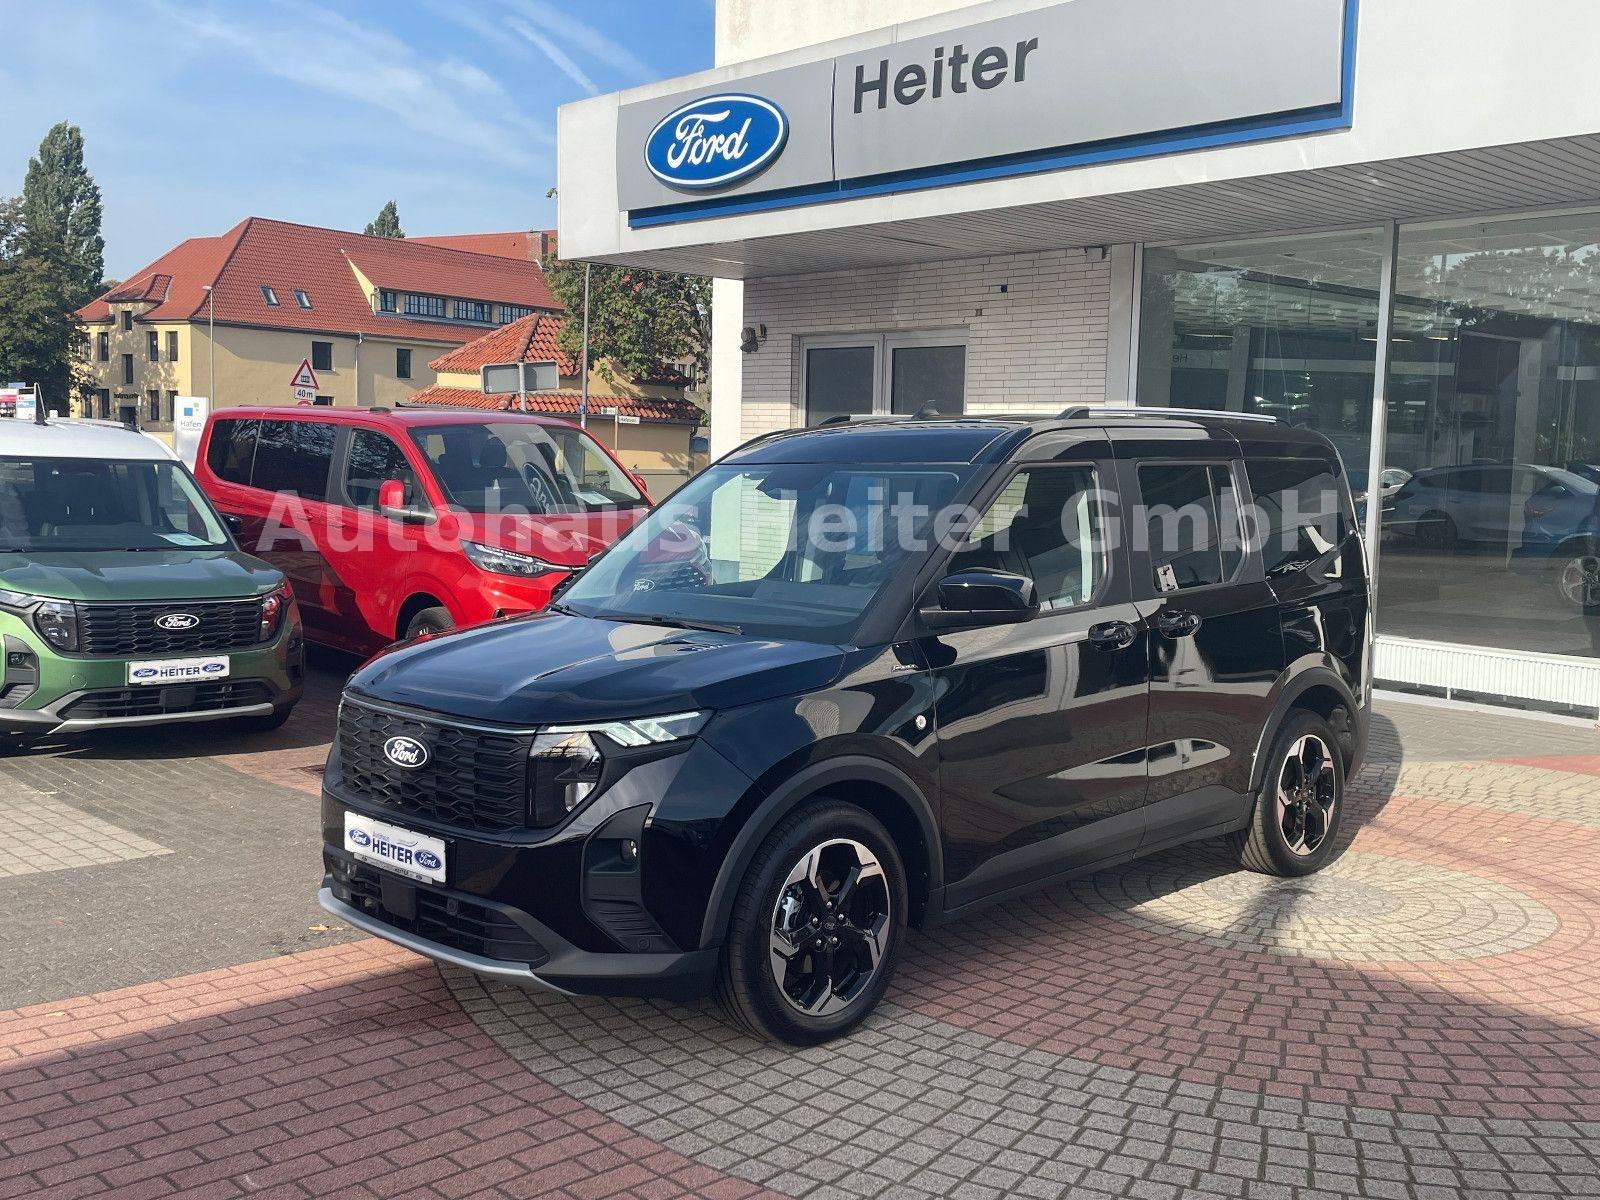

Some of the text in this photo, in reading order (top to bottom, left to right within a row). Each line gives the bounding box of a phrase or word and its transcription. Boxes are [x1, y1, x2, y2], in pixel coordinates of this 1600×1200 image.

[853, 37, 1038, 114] Heiter
[667, 110, 751, 169] Ford
[297, 389, 306, 398] 40
[180, 419, 202, 428] Hafen
[164, 615, 191, 628] Ford
[160, 667, 200, 677] HEITER
[390, 739, 420, 764] Ford
[372, 837, 413, 865] HEITER
[418, 851, 437, 868] Ford
